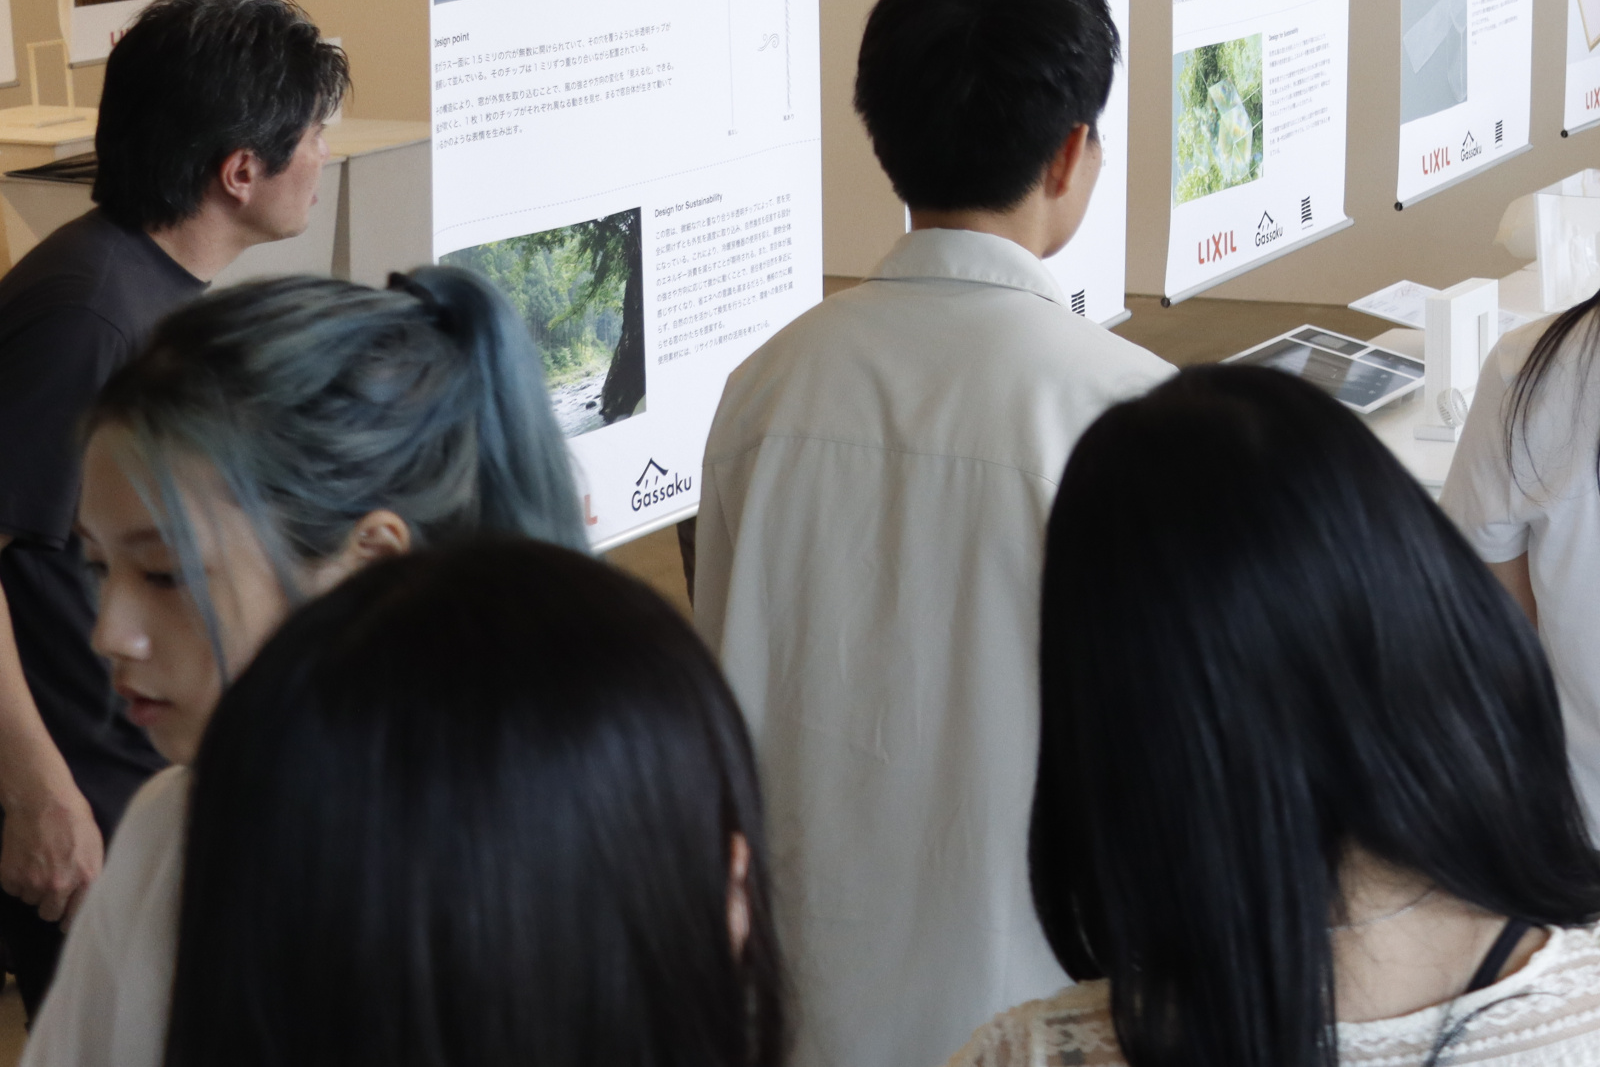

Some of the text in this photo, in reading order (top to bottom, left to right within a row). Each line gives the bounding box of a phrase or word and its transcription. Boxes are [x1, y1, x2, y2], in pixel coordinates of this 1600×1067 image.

[452, 32, 470, 45] point
[1422, 146, 1450, 175] LIXIL
[1460, 142, 1482, 162] Gassaku
[654, 192, 723, 218] Design for Sustainability
[1198, 230, 1237, 264] LIXIL
[1255, 224, 1283, 247] Gassaku
[632, 474, 692, 512] Gassaku
